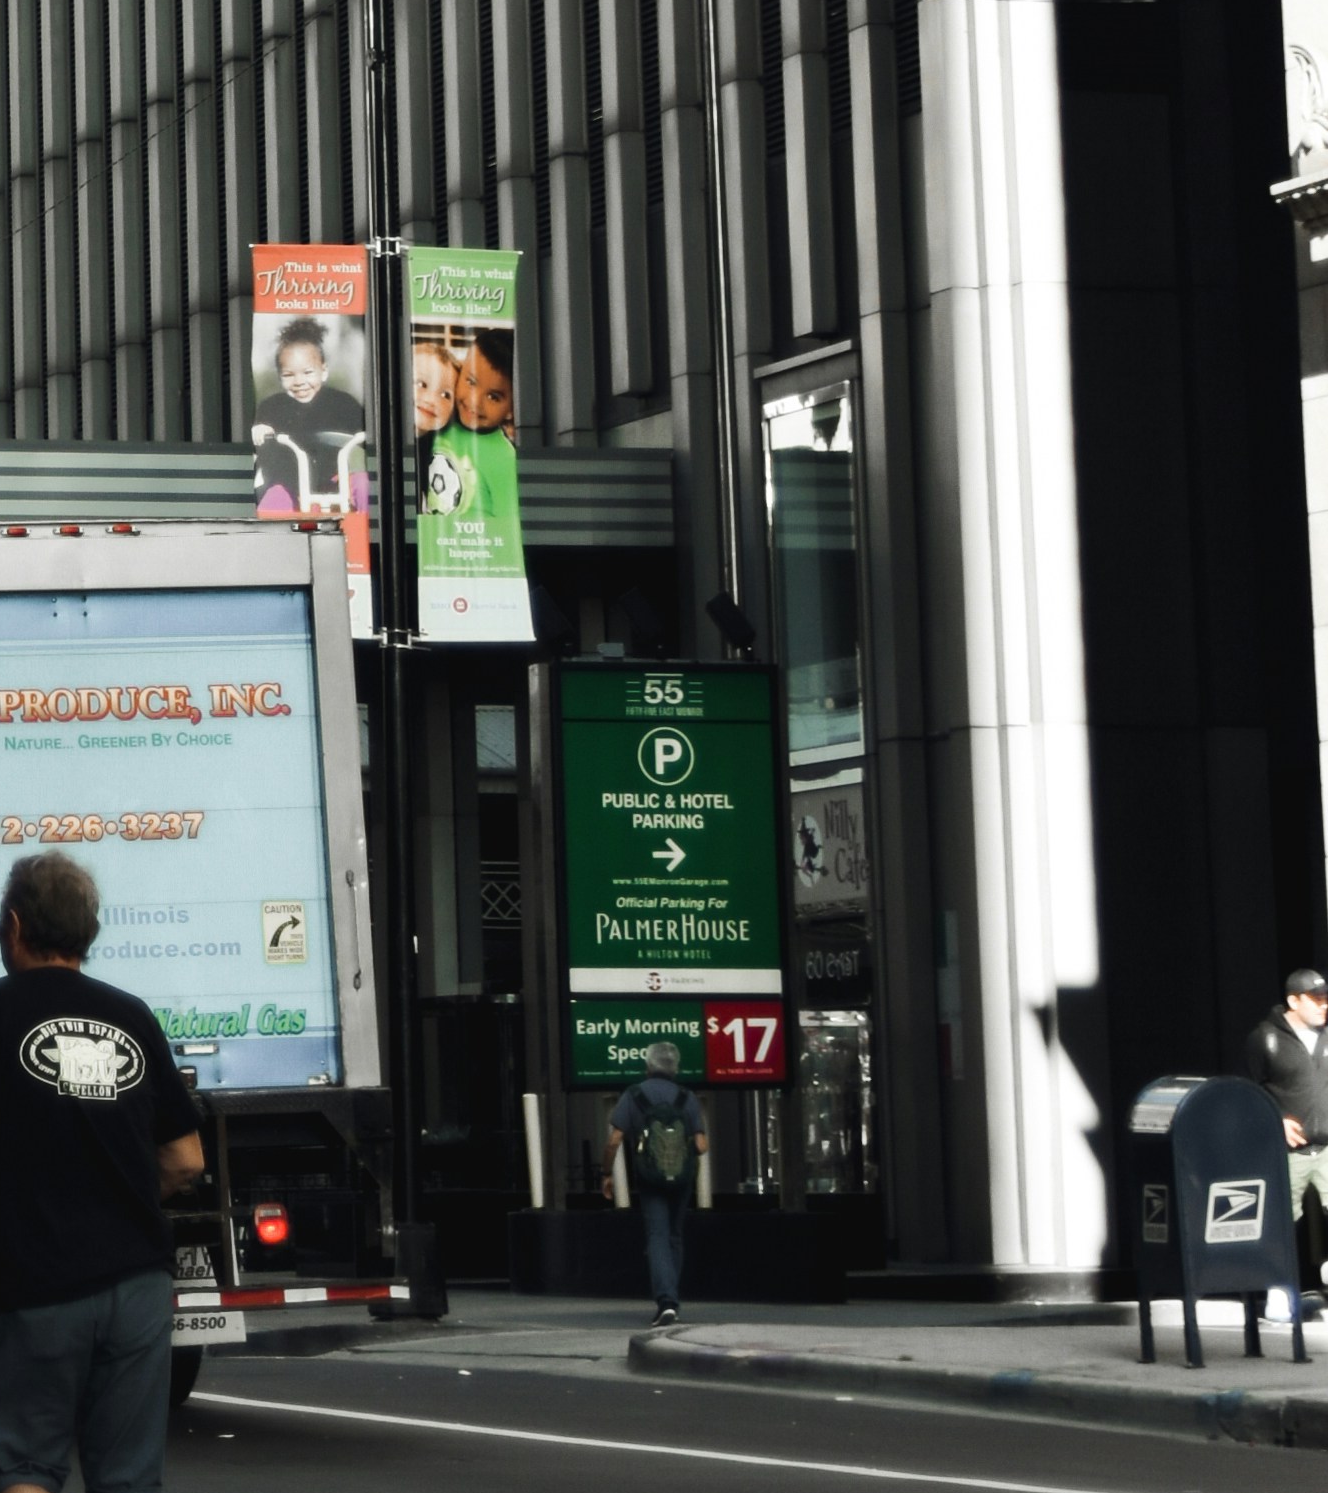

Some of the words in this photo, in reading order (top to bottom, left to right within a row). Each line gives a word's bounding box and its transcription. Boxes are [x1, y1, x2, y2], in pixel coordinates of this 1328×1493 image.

[285, 262, 313, 273] This
[316, 262, 328, 274] is
[331, 263, 363, 275] what
[439, 265, 467, 278] This
[469, 267, 482, 279] is
[484, 268, 515, 281] what
[256, 266, 355, 304] Thriving
[413, 270, 505, 312] Thriving
[275, 298, 309, 310] looks
[311, 299, 339, 310] like!
[431, 301, 463, 315] looks
[464, 303, 492, 316] like!
[454, 521, 486, 535] YOU
[436, 537, 458, 547] can
[460, 536, 492, 547] make
[494, 537, 505, 547] it
[448, 547, 494, 561] happen.
[643, 679, 685, 705] 55
[207, 682, 293, 720] INC.
[77, 733, 148, 750] GREENER
[151, 732, 173, 748] BY
[176, 731, 233, 747] CHOICE
[601, 792, 661, 809] PUBLIC
[663, 793, 676, 809] &
[680, 793, 734, 810] HOTEL
[632, 813, 705, 830] PARKING
[264, 904, 302, 914] CAUTION
[615, 896, 658, 909] Official
[660, 897, 705, 911] Parking
[707, 898, 729, 910] For
[646, 949, 680, 959] HILTON
[683, 950, 712, 960] HOTEL
[257, 1002, 307, 1035] Gas
[40, 1021, 58, 1039] BIG
[57, 1020, 85, 1034] TWIN
[575, 1018, 621, 1038] Early
[624, 1018, 701, 1038] Morning
